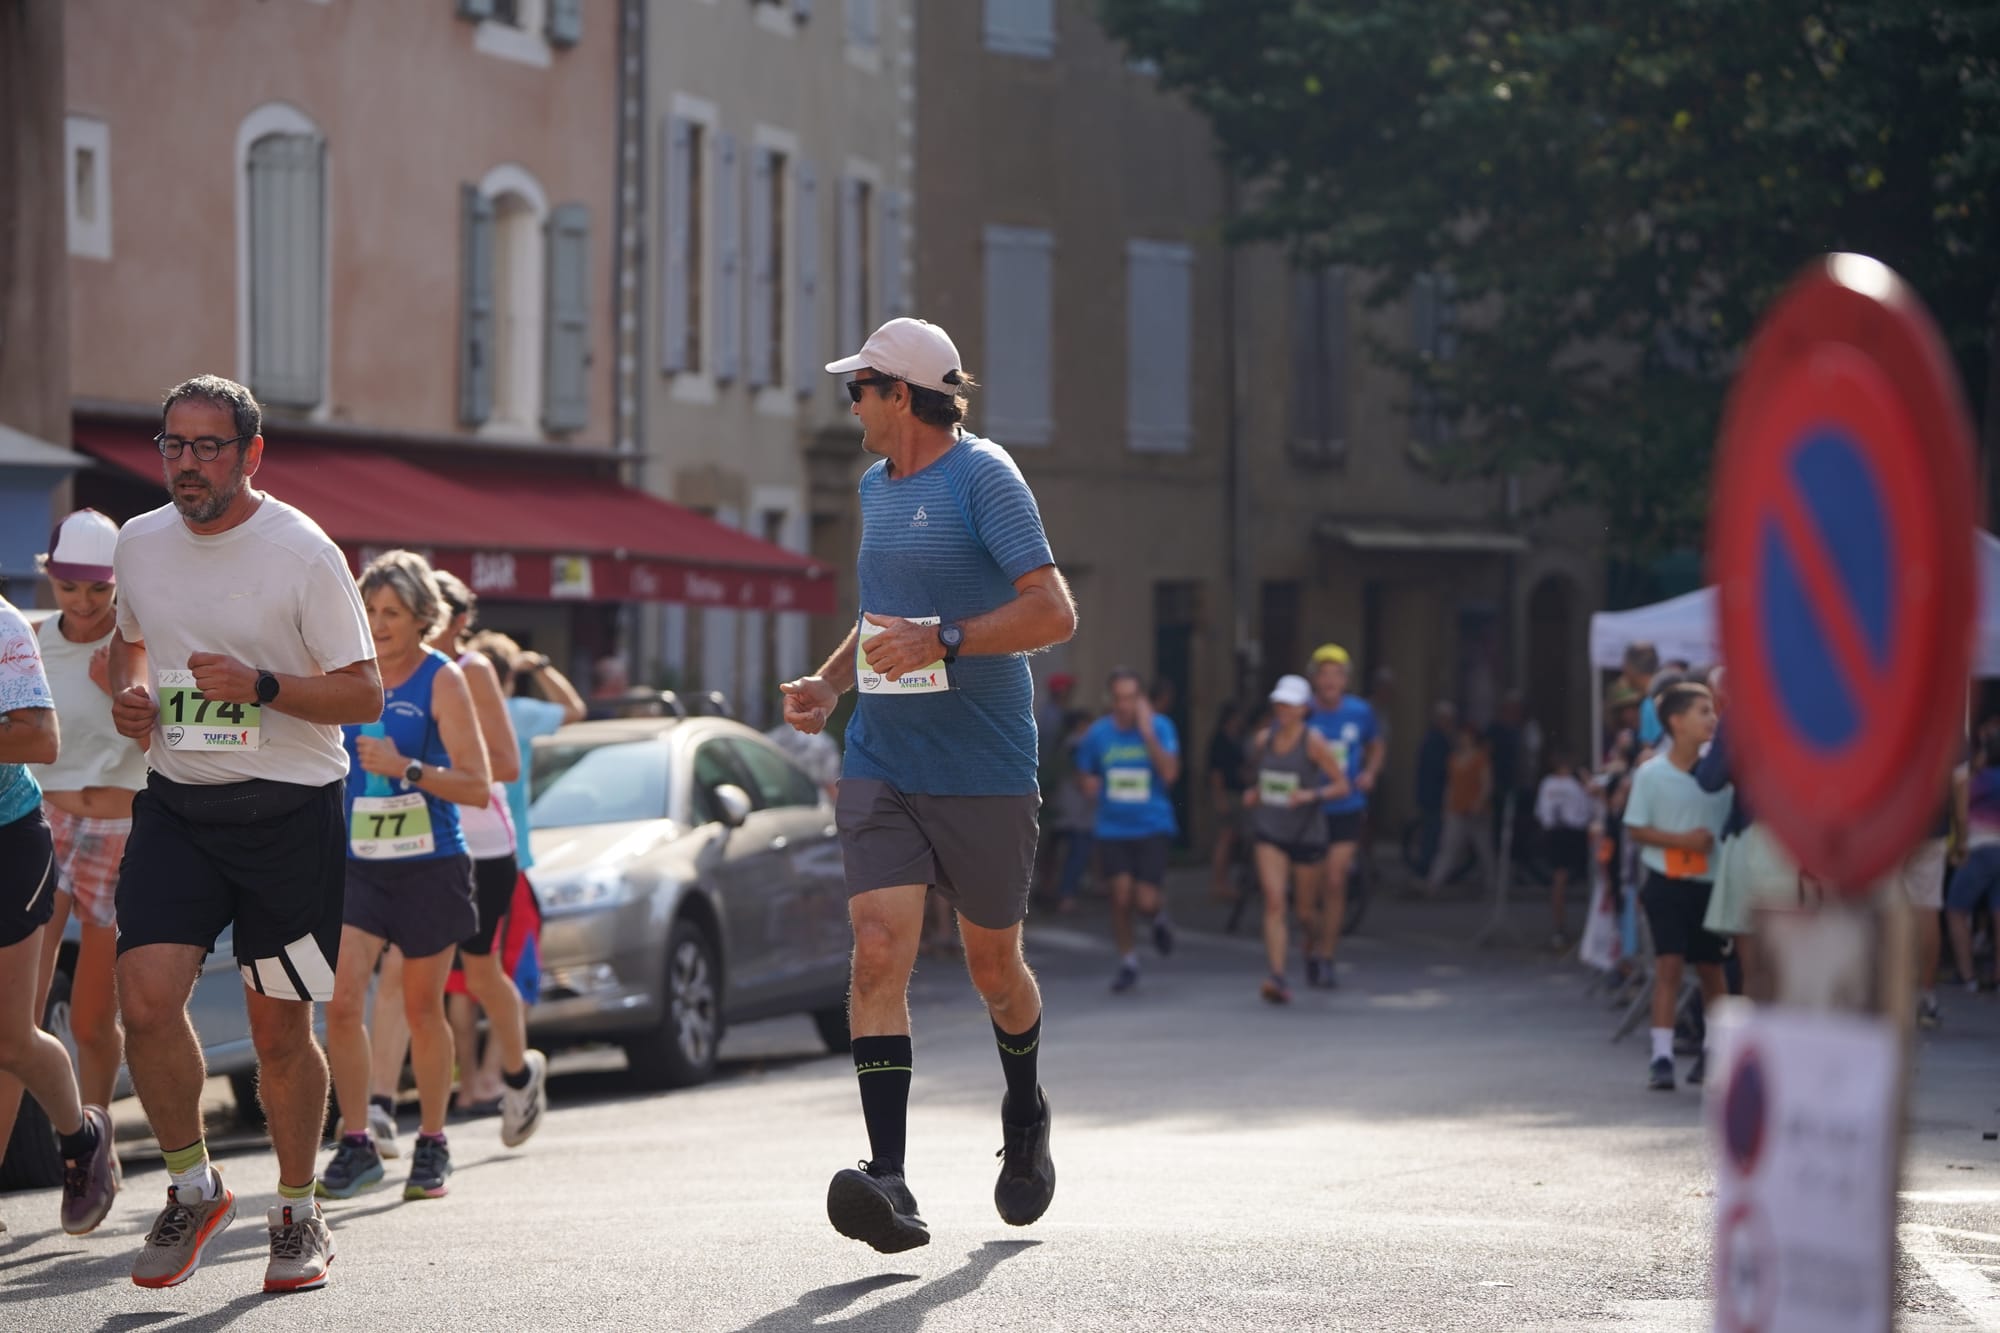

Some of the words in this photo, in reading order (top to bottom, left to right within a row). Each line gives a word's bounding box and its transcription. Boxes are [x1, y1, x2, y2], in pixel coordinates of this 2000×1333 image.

[471, 553, 517, 591] BAR
[203, 733, 238, 741] TUFF'S
[369, 813, 407, 837] 77
[857, 1060, 891, 1069] ALKE
